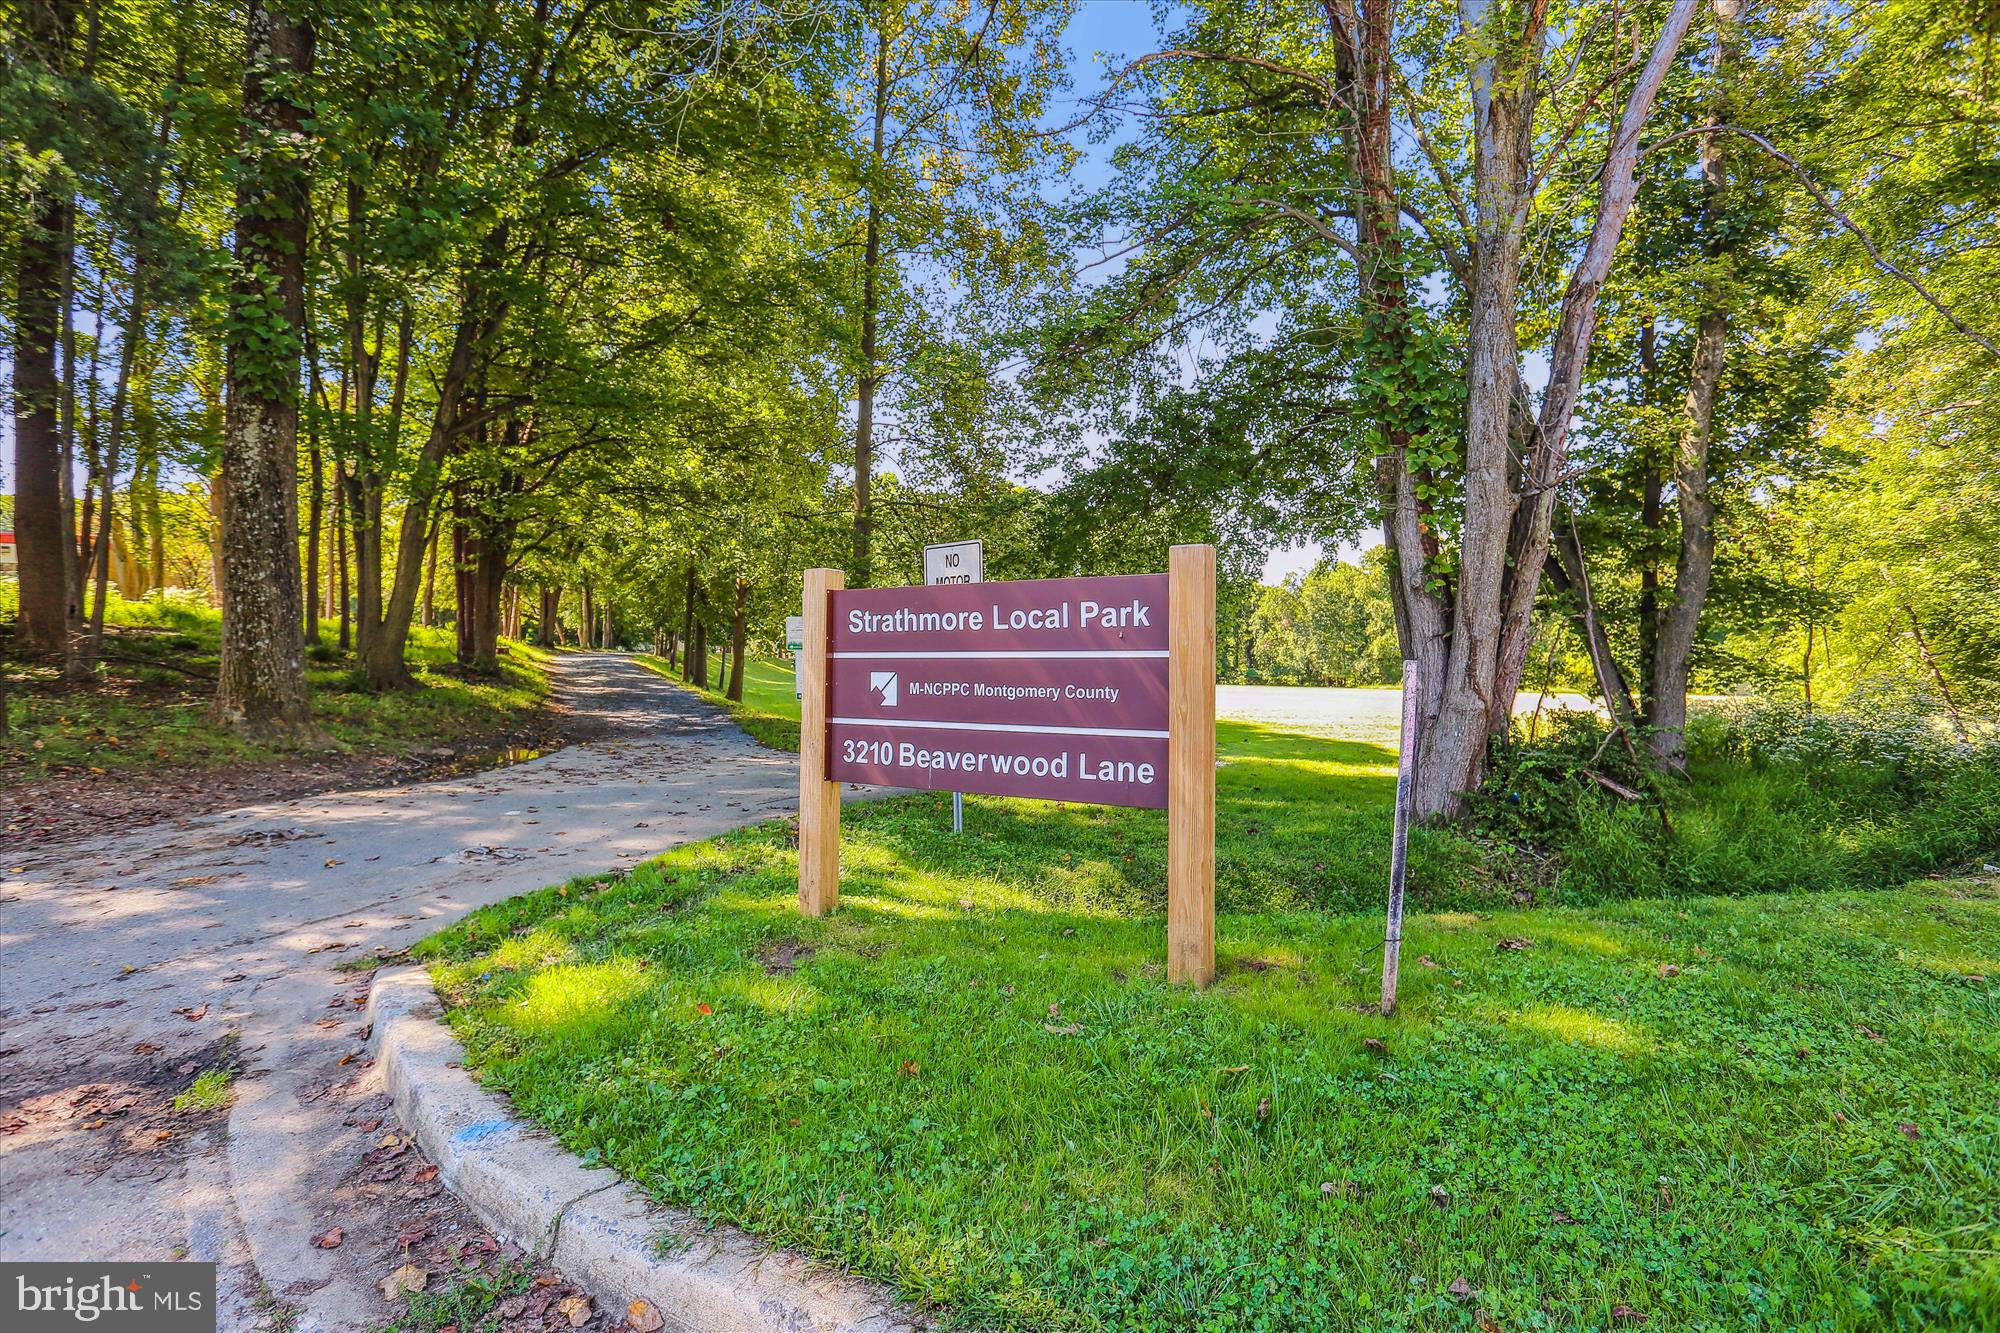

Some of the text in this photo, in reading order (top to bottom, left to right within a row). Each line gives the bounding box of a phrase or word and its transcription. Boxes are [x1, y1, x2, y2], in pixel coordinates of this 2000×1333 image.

[945, 553, 960, 568] NO
[848, 599, 1151, 634] Strathmore Local Park
[909, 682, 1120, 704] M-NCPPC Montgomery County
[842, 739, 1155, 785] 3210 Beaverwood Lane
